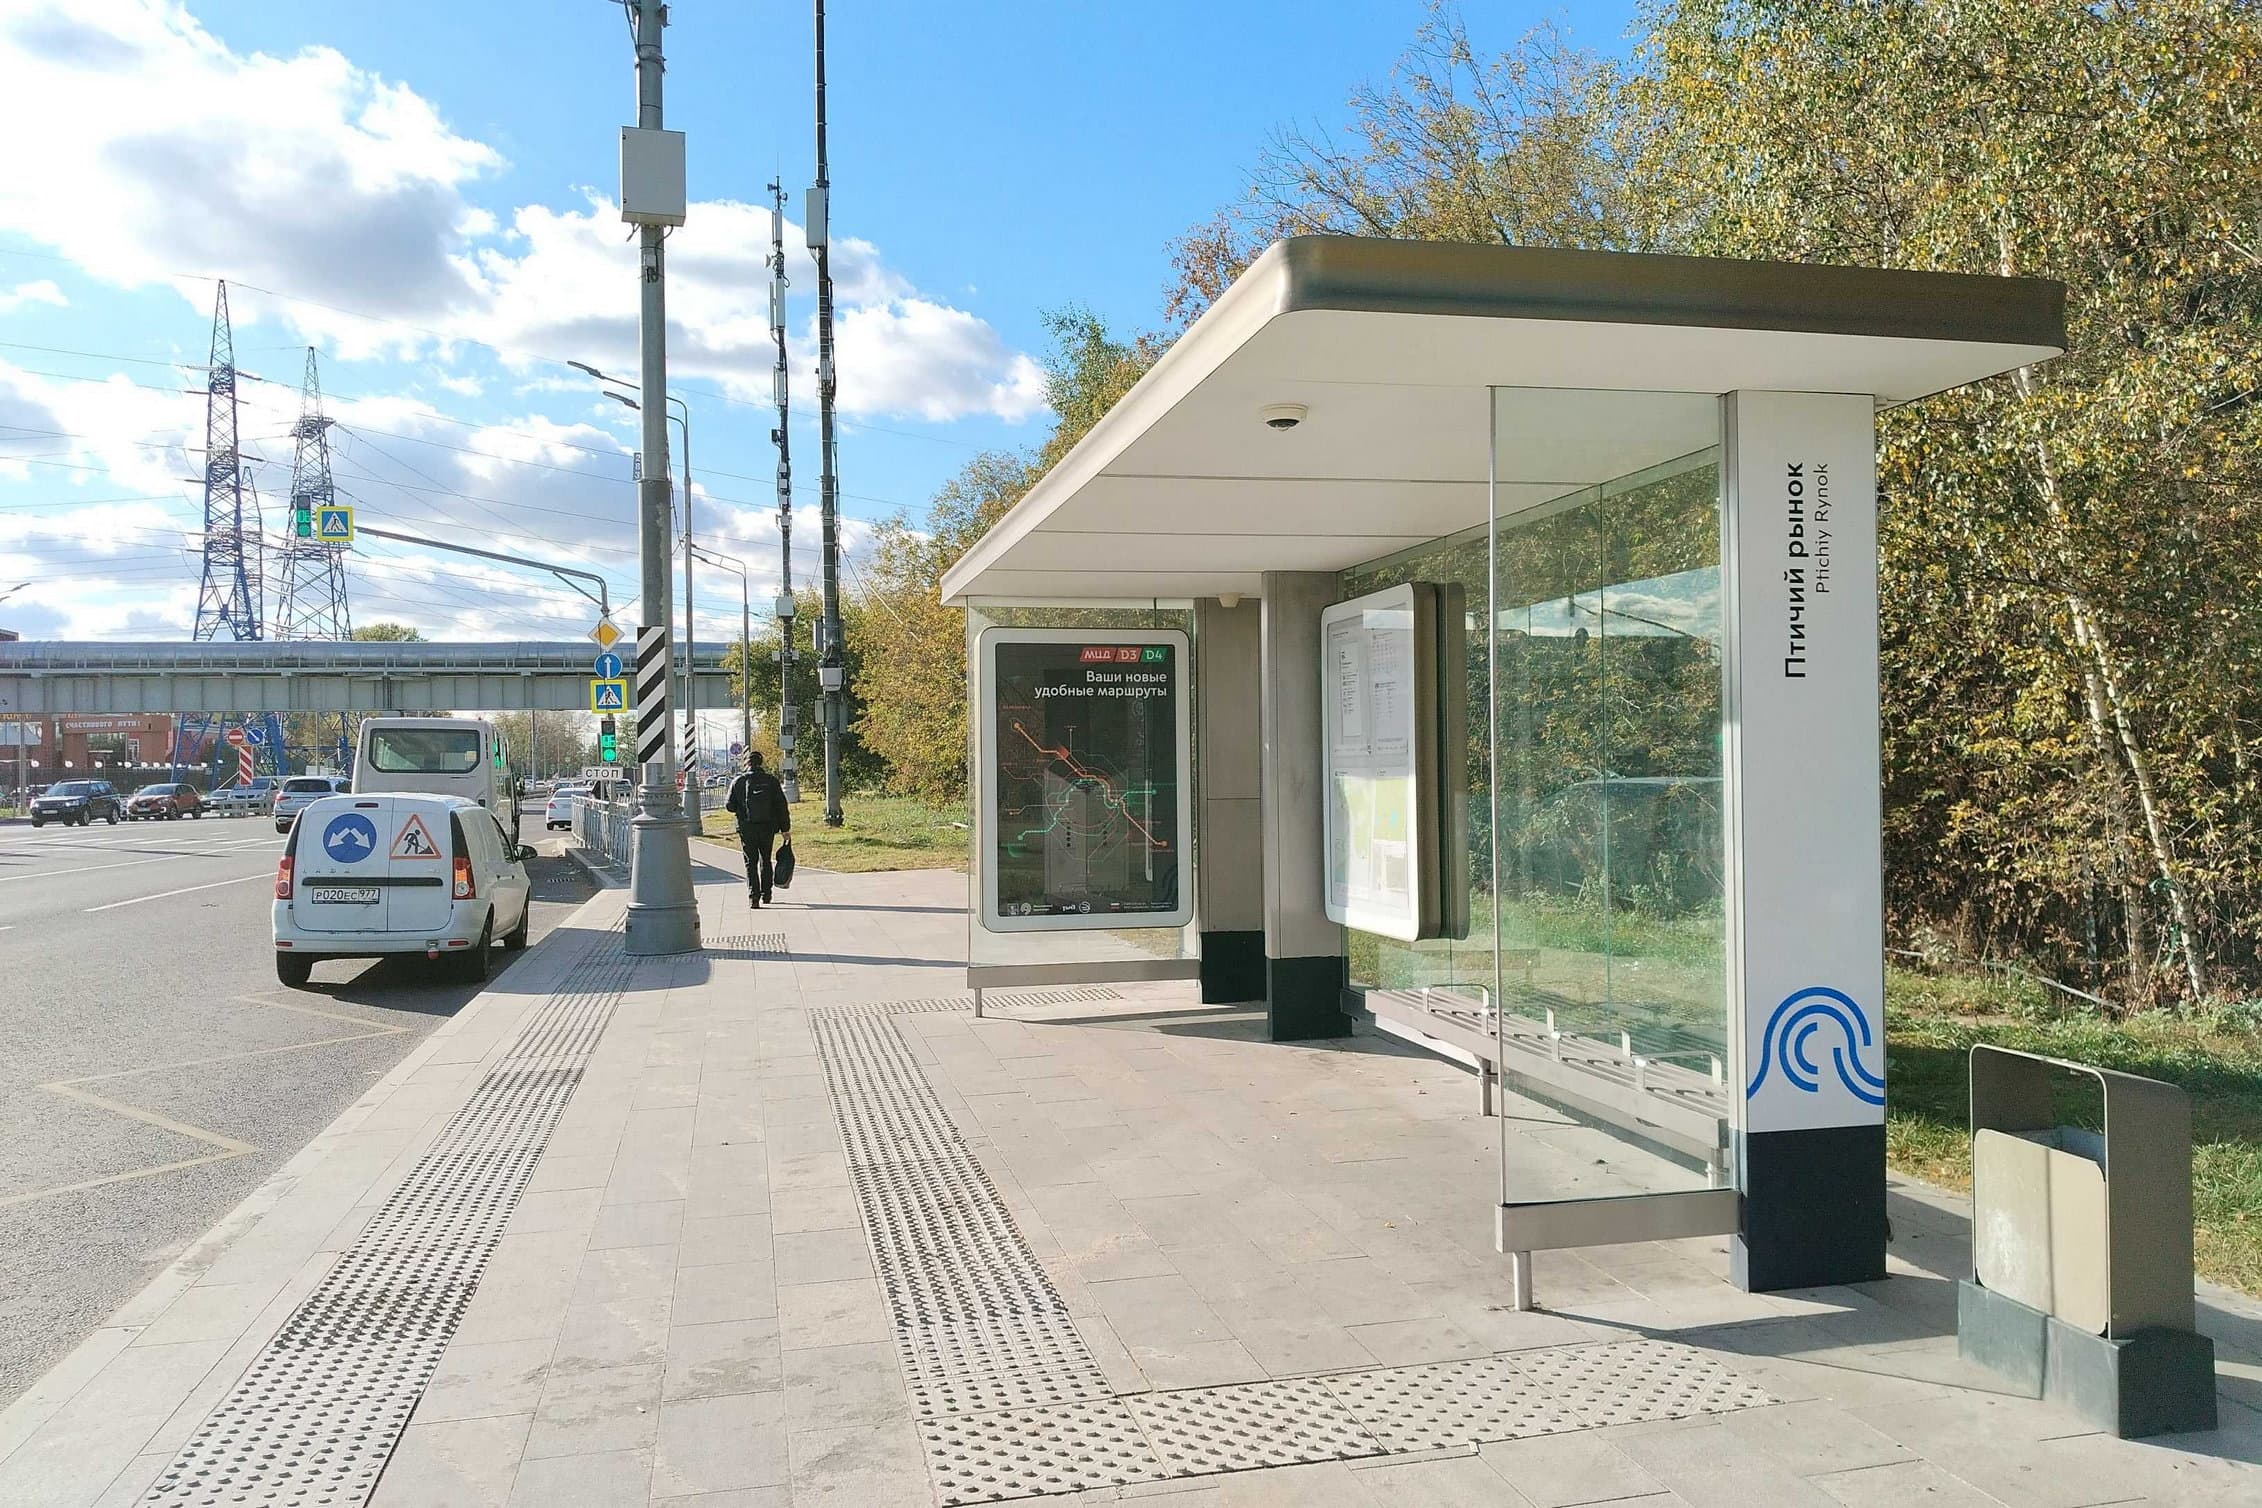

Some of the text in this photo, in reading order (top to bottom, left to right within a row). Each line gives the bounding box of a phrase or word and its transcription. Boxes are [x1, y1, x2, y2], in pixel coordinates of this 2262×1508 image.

[1813, 463, 1832, 593] Ptichiy Rynok
[1784, 462, 1809, 678] Птичий рынок
[1084, 650, 1163, 660] МЦД D3 D4
[1086, 671, 1167, 682] Ваши новые
[1034, 684, 1167, 699] удобные маршруты
[585, 769, 619, 778] СТОП
